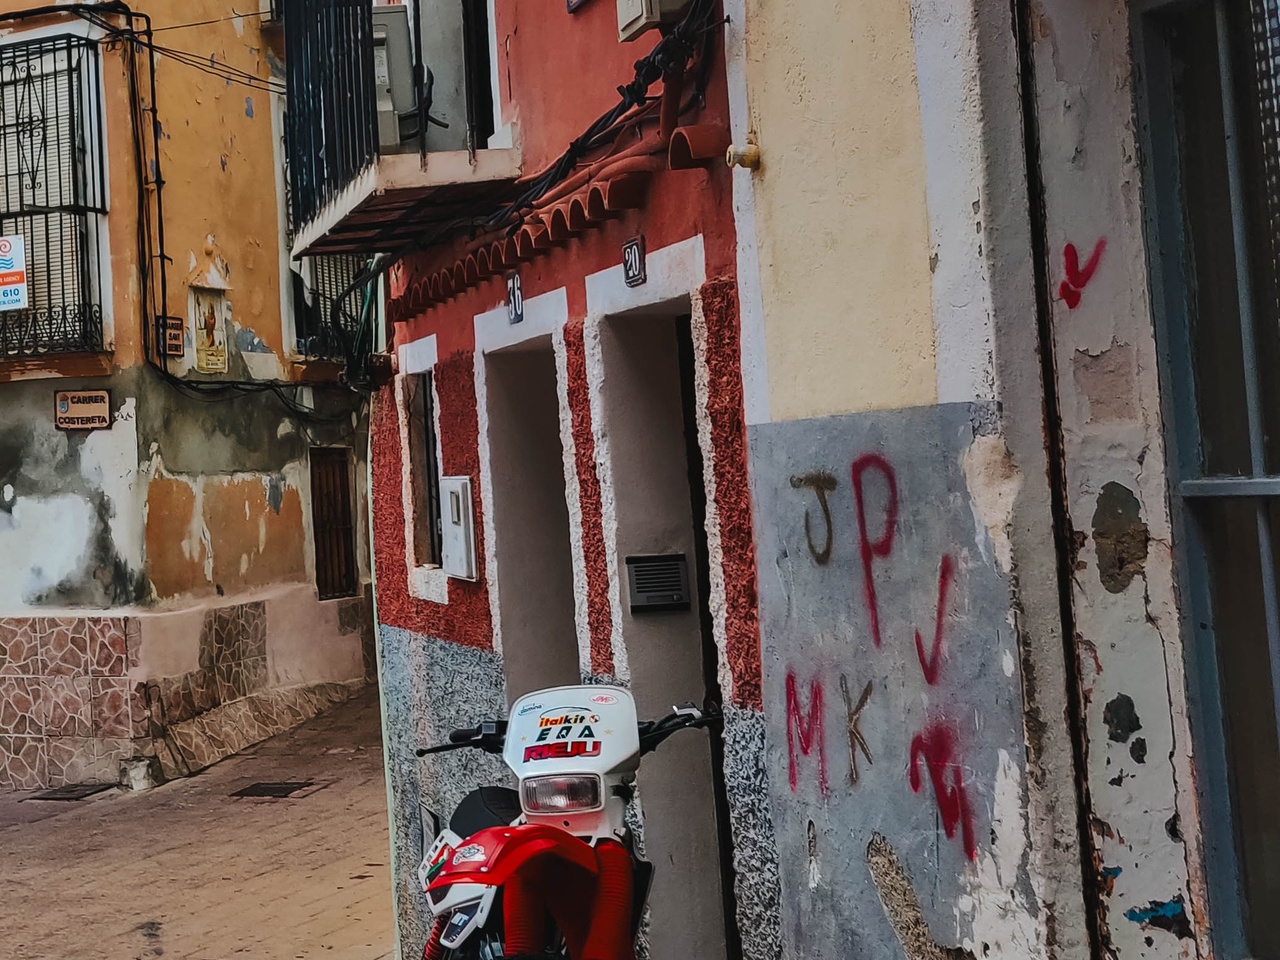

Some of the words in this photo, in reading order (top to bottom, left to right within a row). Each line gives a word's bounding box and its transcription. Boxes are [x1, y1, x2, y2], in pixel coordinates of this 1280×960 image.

[625, 245, 639, 277] 20
[2, 288, 20, 298] 610
[507, 273, 522, 320] 36
[70, 395, 106, 405] CARRER
[58, 415, 108, 425] COSTERETA
[539, 714, 586, 728] italkit
[522, 741, 602, 763] RIEJU
